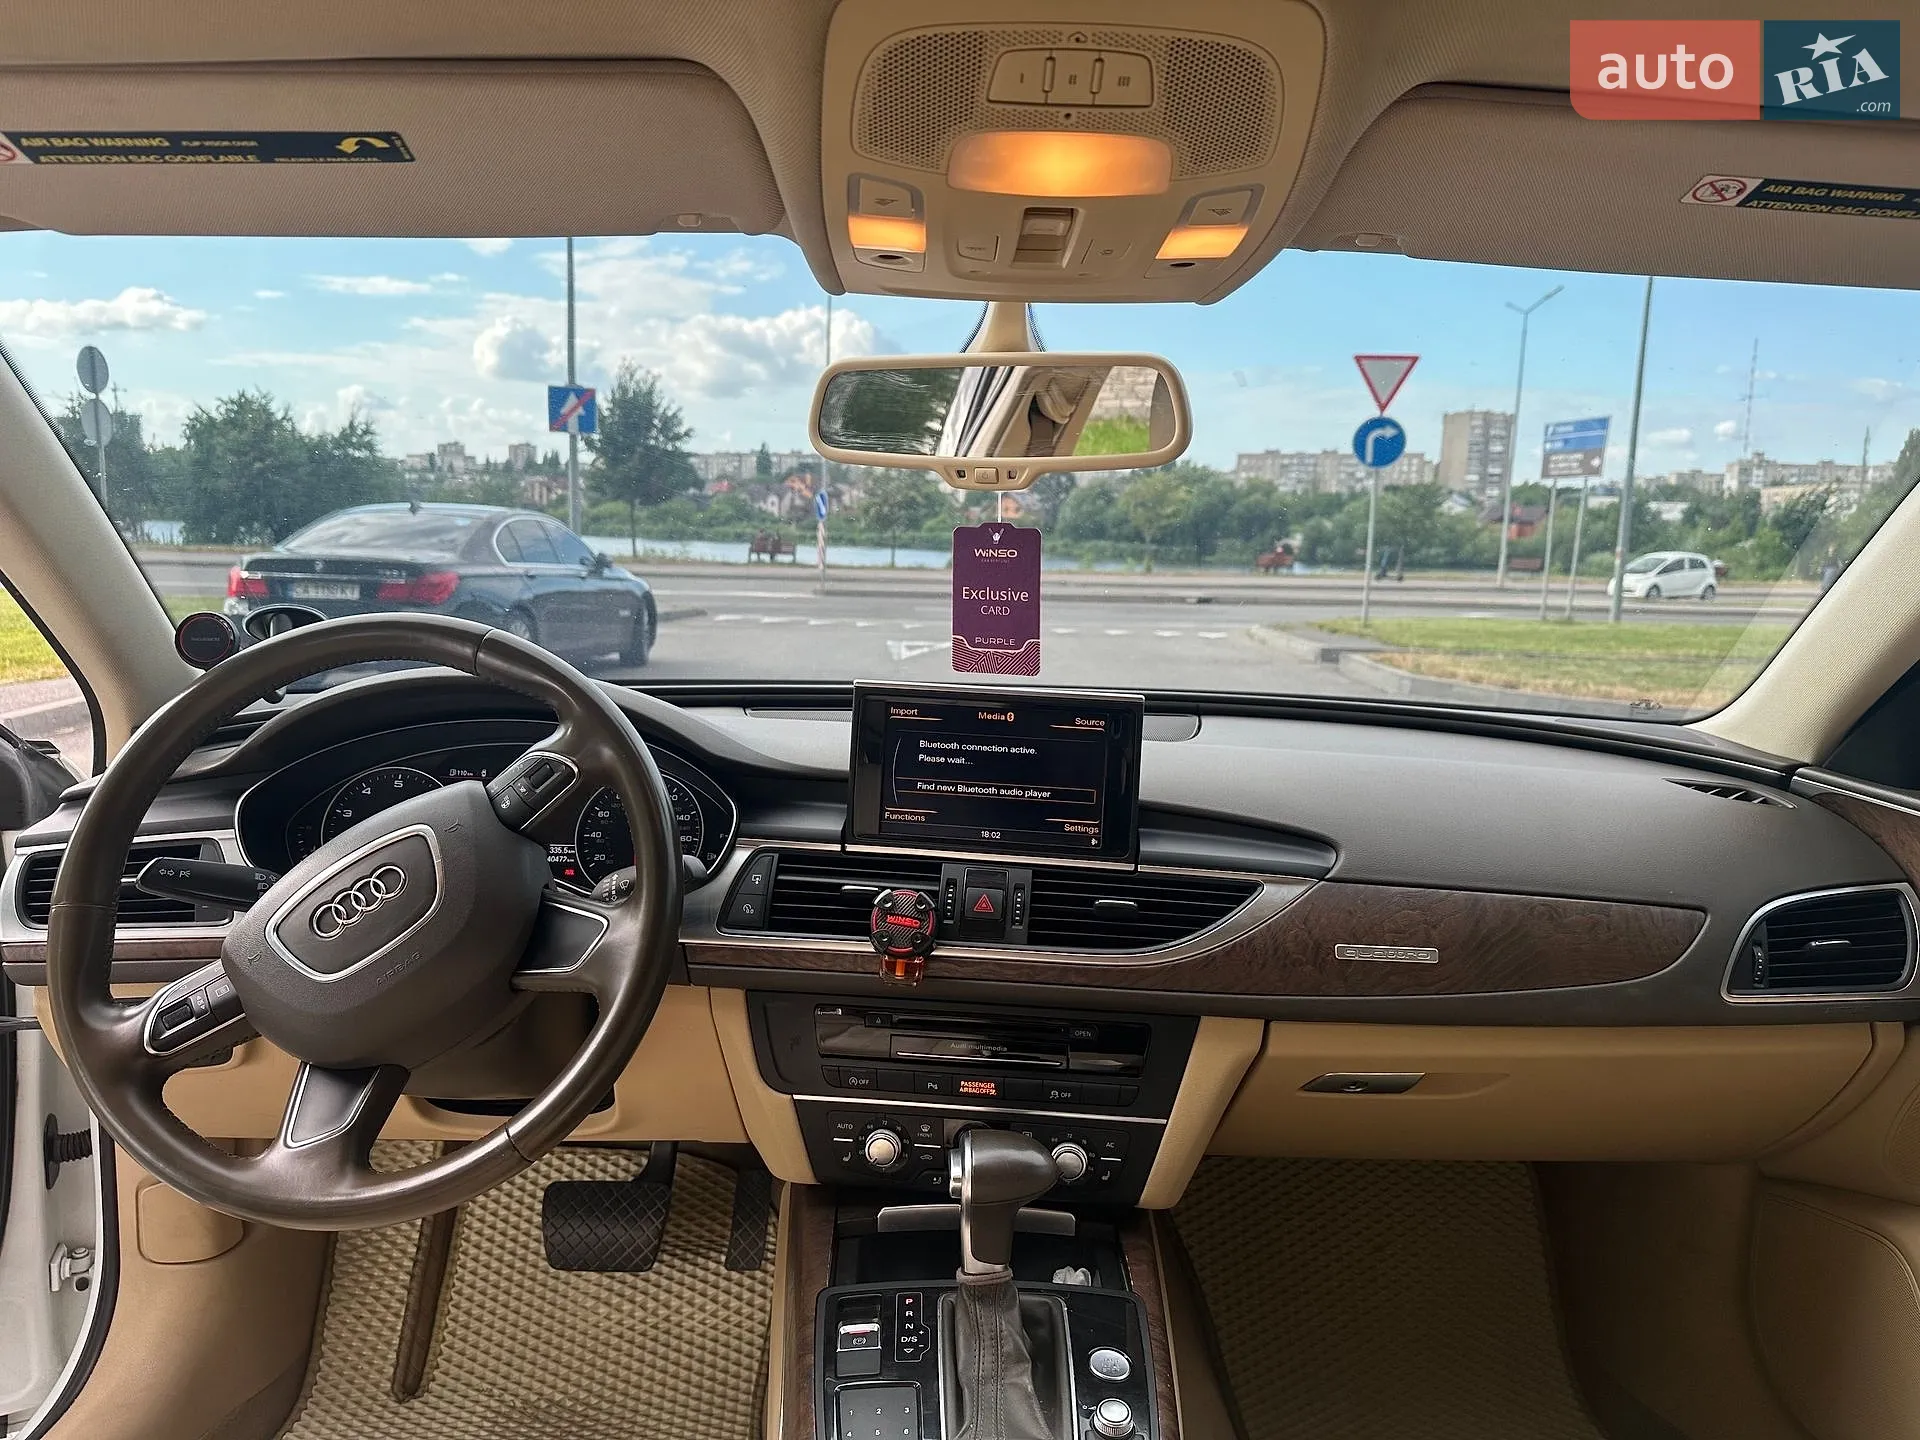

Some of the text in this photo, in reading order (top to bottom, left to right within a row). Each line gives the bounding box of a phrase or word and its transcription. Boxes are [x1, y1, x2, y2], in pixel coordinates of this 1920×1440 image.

[20, 137, 170, 147] AIR BAG WARNING
[40, 154, 128, 163] ATTENTION
[128, 154, 164, 163] SAC
[1762, 185, 1793, 194] AIR
[1793, 186, 1828, 197] BAG
[1830, 189, 1906, 202] WARNING
[1747, 200, 1831, 212] ATTENTION
[1831, 205, 1866, 215] SAC
[962, 586, 1029, 602] Exclusive
[980, 605, 1010, 616] CARD
[974, 636, 1016, 646] PURPLE
[890, 706, 918, 717] Import
[978, 711, 1006, 721] Media
[1074, 717, 1105, 727] Source
[919, 740, 1038, 755] Bluetooth connection active.
[918, 754, 974, 765] Please wait...
[394, 779, 404, 789] 5
[361, 787, 371, 796] 4
[917, 782, 1052, 799] Find new Bluetooth audio player
[342, 809, 353, 818] 3
[597, 810, 610, 818] 60
[884, 812, 926, 822] Functions
[1064, 823, 1099, 834] Settings
[981, 830, 1001, 839] 18:02
[1074, 1030, 1092, 1038] OPEN
[960, 1080, 996, 1089] PASSENGER
